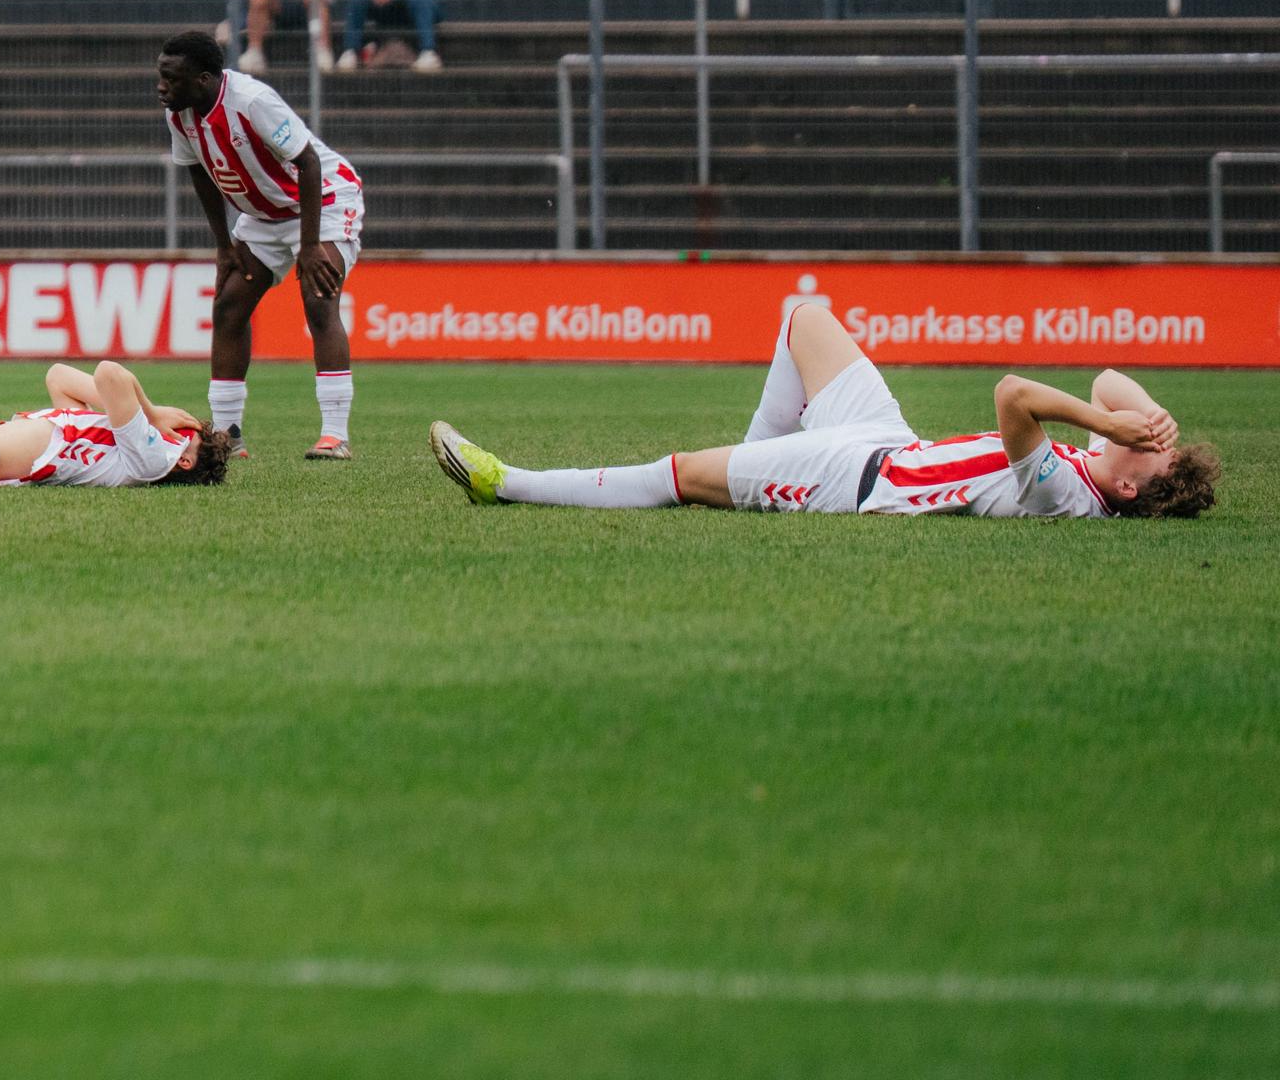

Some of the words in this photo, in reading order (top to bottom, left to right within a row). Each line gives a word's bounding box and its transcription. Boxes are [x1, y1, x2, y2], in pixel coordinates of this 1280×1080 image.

[272, 124, 290, 146] SAP
[365, 304, 539, 348] Sparkasse
[545, 304, 712, 342] KölnBonn
[845, 306, 1025, 350] Sparkasse
[1033, 306, 1206, 345] KölnBonn
